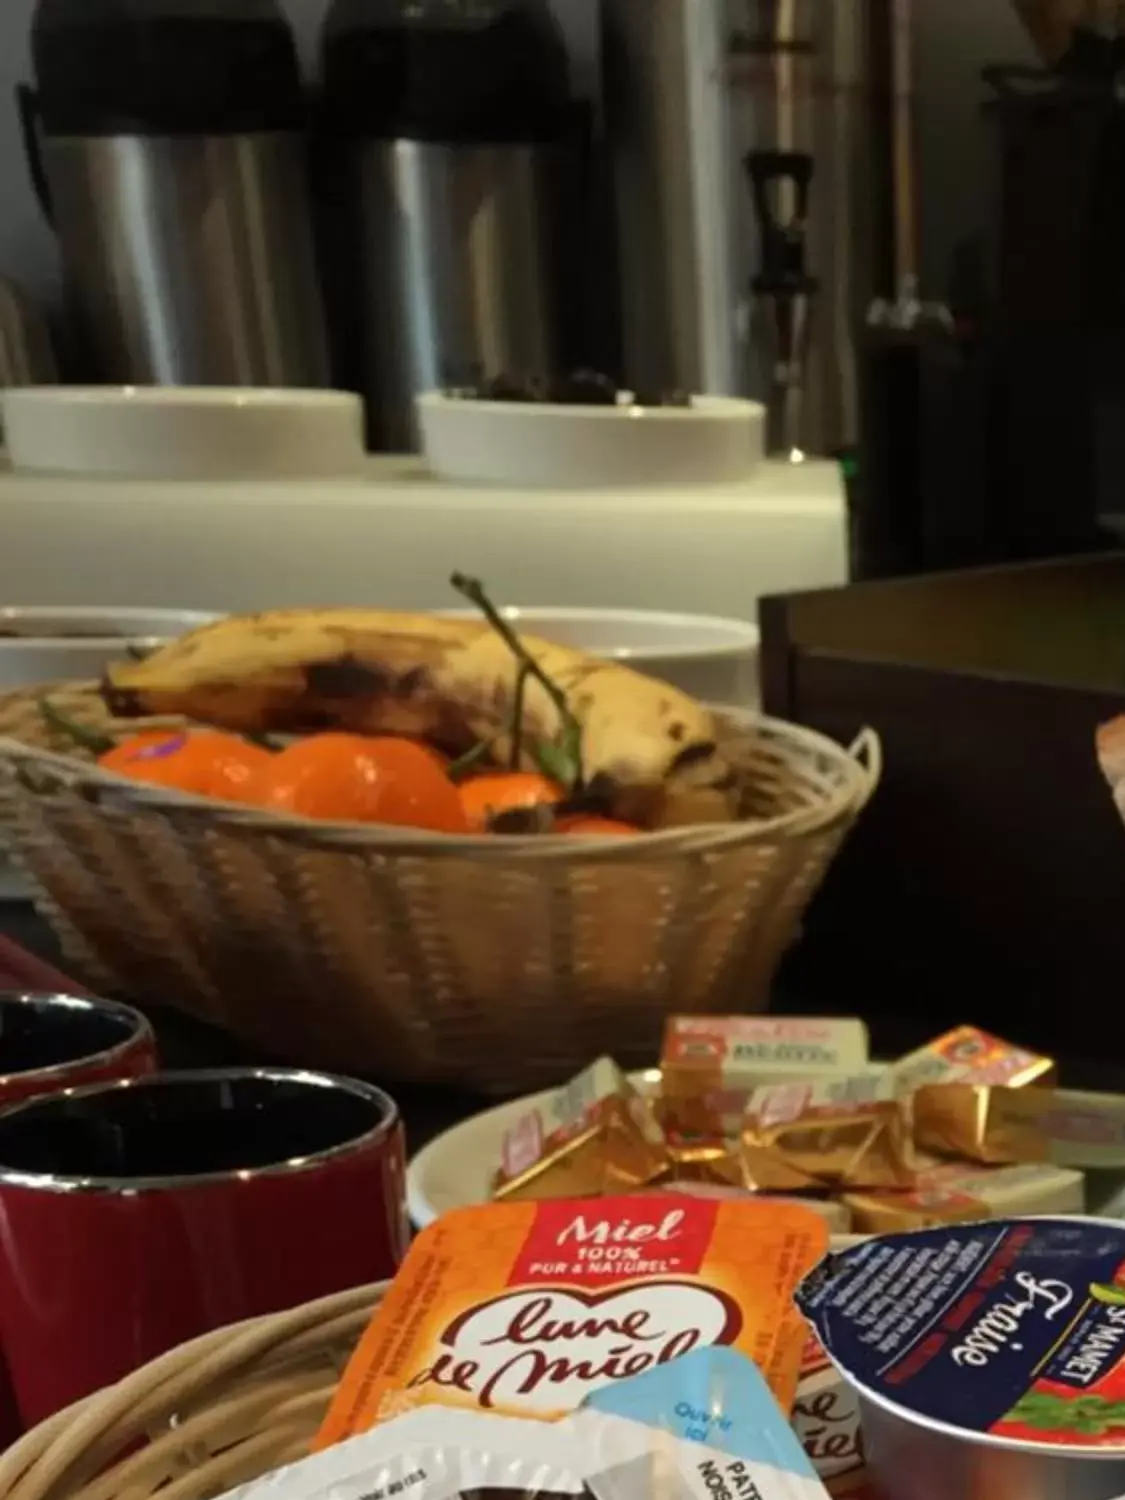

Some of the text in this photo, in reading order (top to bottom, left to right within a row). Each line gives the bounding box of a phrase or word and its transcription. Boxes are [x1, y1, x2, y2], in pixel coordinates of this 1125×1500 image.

[557, 1209, 685, 1246] Miel
[530, 1261, 567, 1274] PUR
[571, 1261, 584, 1273] &
[577, 1245, 642, 1261] 100%
[951, 1270, 1073, 1368] Fraise
[408, 1347, 473, 1391] de
